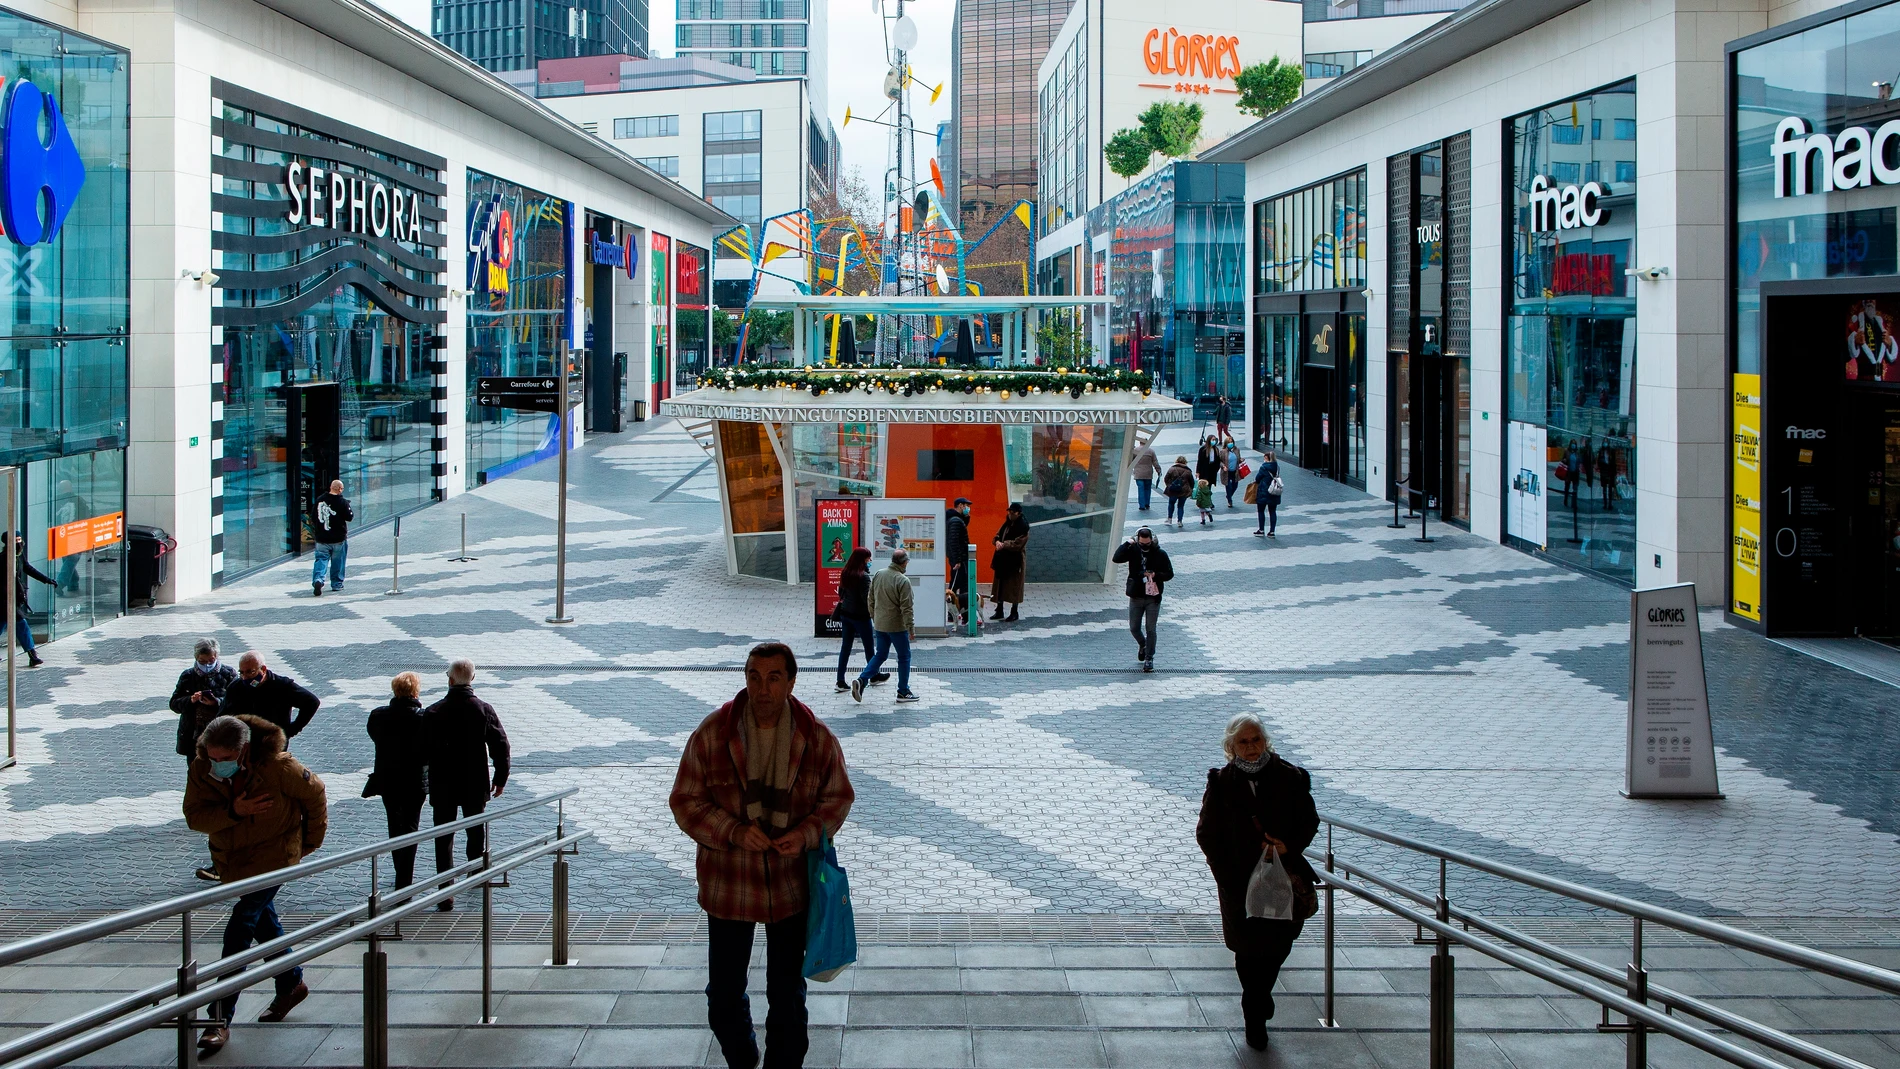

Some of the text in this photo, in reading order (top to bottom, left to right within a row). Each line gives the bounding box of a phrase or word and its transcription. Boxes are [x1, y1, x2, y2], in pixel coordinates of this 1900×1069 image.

[288, 161, 421, 243] SEPHORA
[1529, 174, 1602, 233] fnac
[1417, 223, 1440, 244] TOUS
[1786, 425, 1826, 439] fnac
[1781, 486, 1791, 515] 1
[823, 509, 852, 518] BACK TO
[827, 519, 848, 527] XMAS
[1776, 528, 1796, 557] 0
